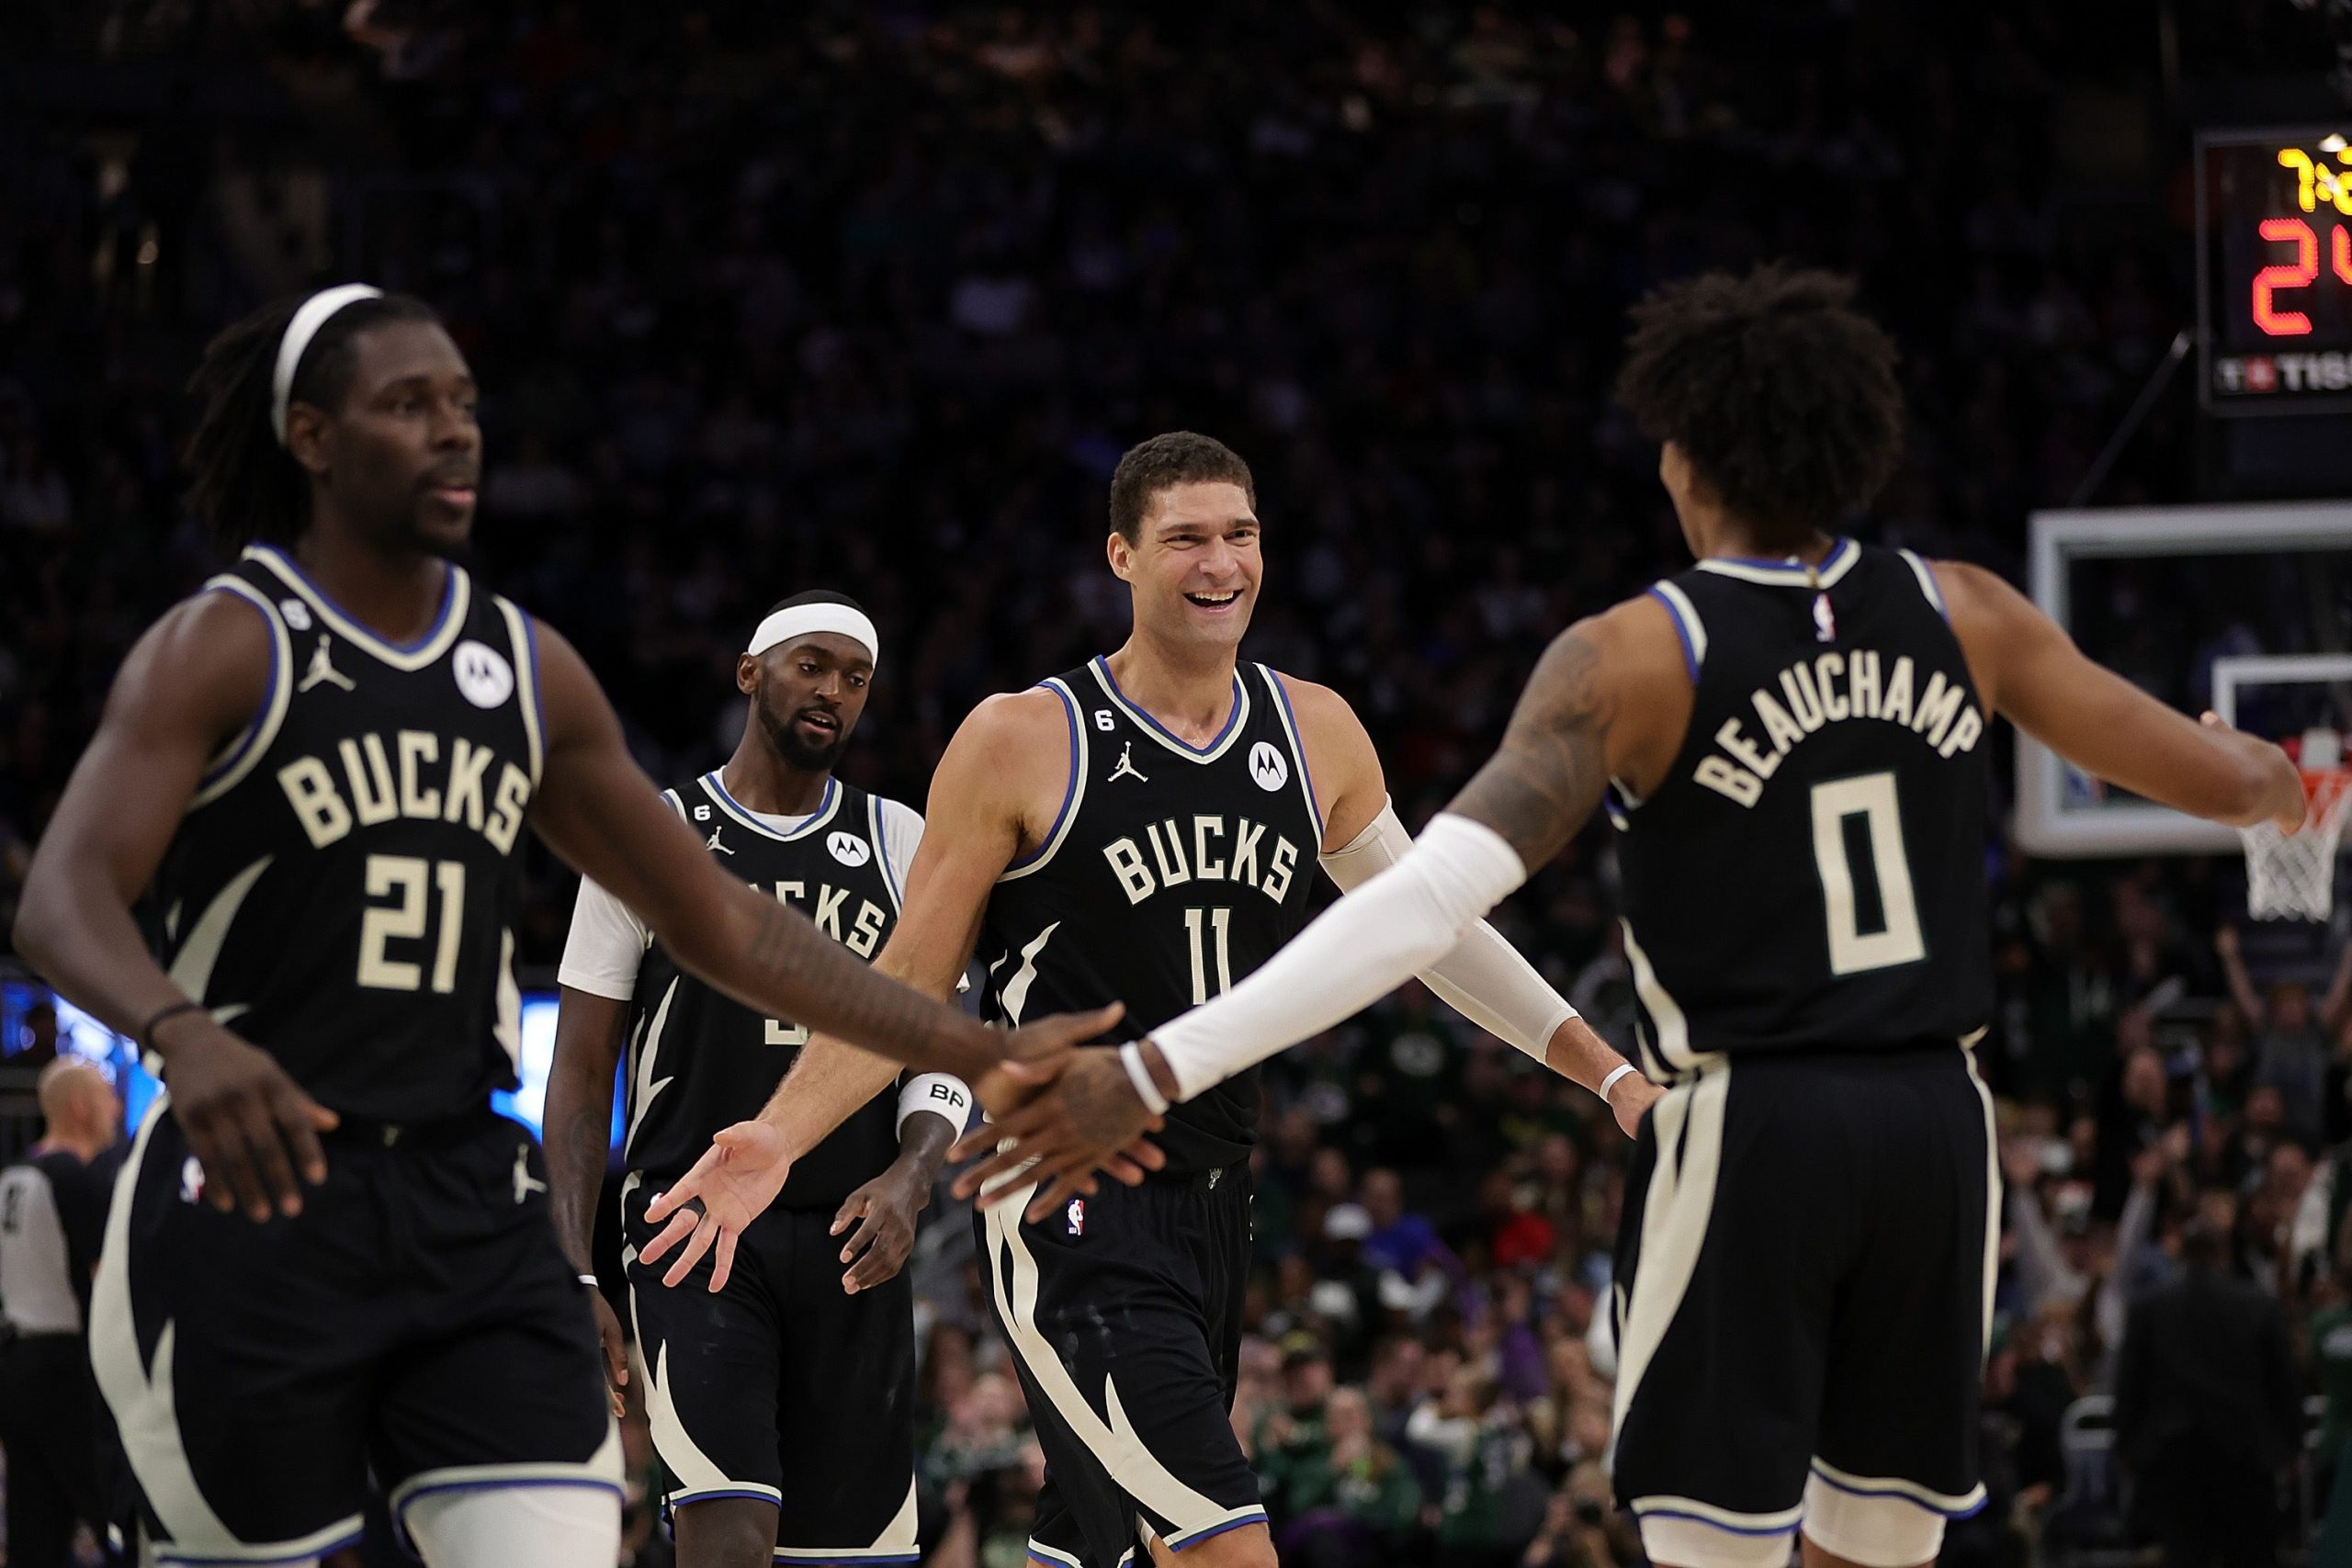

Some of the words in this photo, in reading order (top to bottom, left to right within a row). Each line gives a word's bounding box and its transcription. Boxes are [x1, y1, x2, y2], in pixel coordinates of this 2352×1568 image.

[2277, 352, 2352, 391] TIS
[1094, 709, 1115, 731] 6
[1693, 649, 1984, 809] BEAUCHAMP
[277, 729, 531, 855] BUCKS
[694, 804, 711, 821] 6
[1102, 814, 1298, 905] BUCKS
[1811, 771, 1927, 976] 0
[356, 854, 465, 993] 21
[1184, 908, 1232, 1006] 11
[930, 1083, 965, 1109] BP
